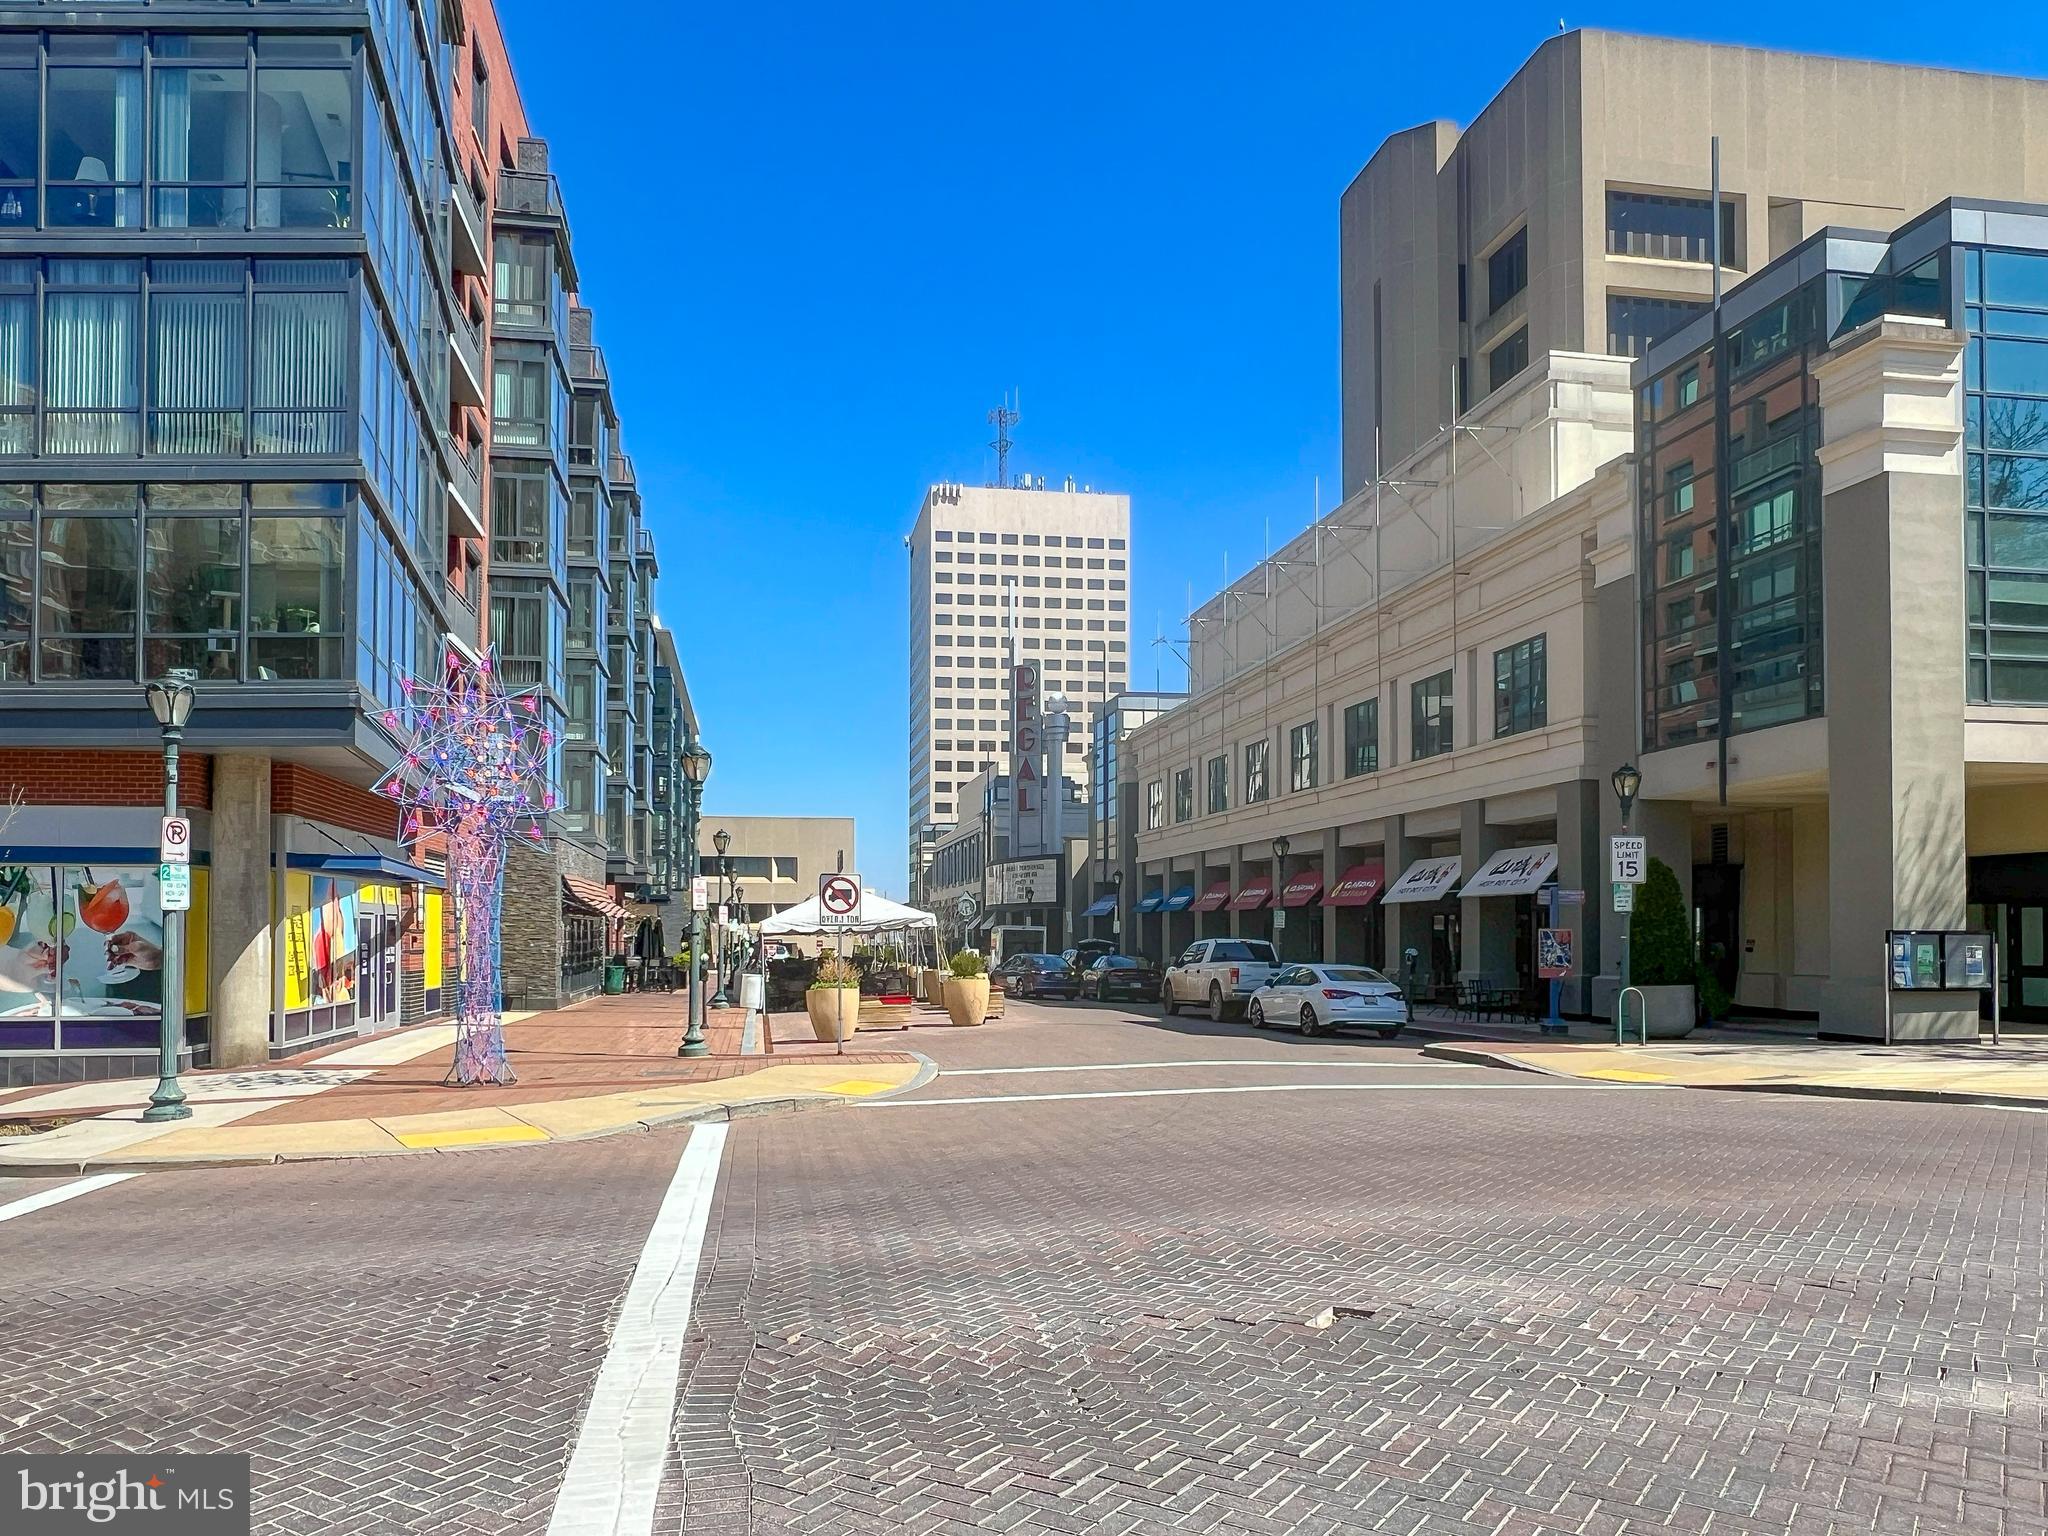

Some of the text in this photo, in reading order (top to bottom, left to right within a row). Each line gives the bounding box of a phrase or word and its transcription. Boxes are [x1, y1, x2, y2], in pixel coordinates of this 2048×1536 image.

[1016, 666, 1037, 812] REGAL
[1614, 841, 1643, 850] SPEED
[1616, 851, 1639, 859] LIMIT
[1618, 860, 1639, 877] 15
